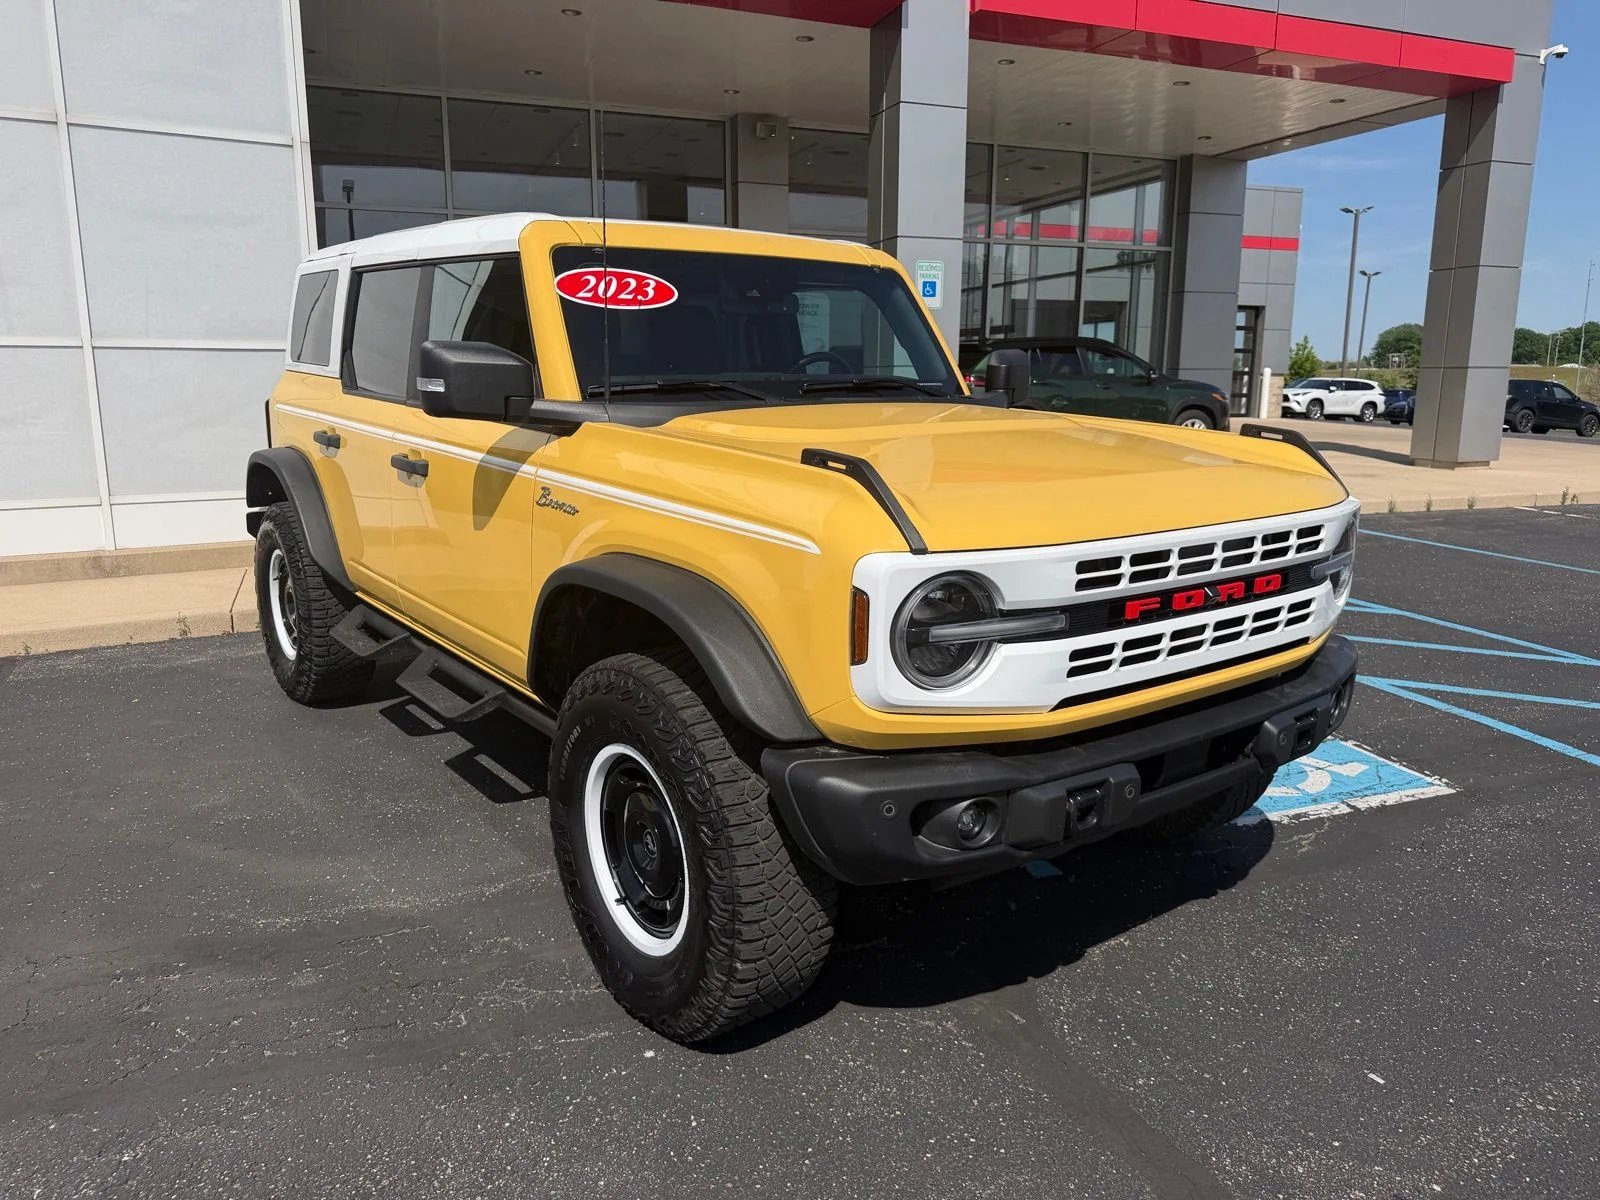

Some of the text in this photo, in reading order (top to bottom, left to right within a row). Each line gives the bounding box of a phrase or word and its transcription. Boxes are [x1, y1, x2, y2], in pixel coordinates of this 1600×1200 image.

[918, 264, 943, 272] RESERVED
[919, 272, 940, 280] PARKING
[575, 274, 657, 301] 2023
[535, 486, 580, 517] Bronco
[1124, 573, 1283, 620] FORD
